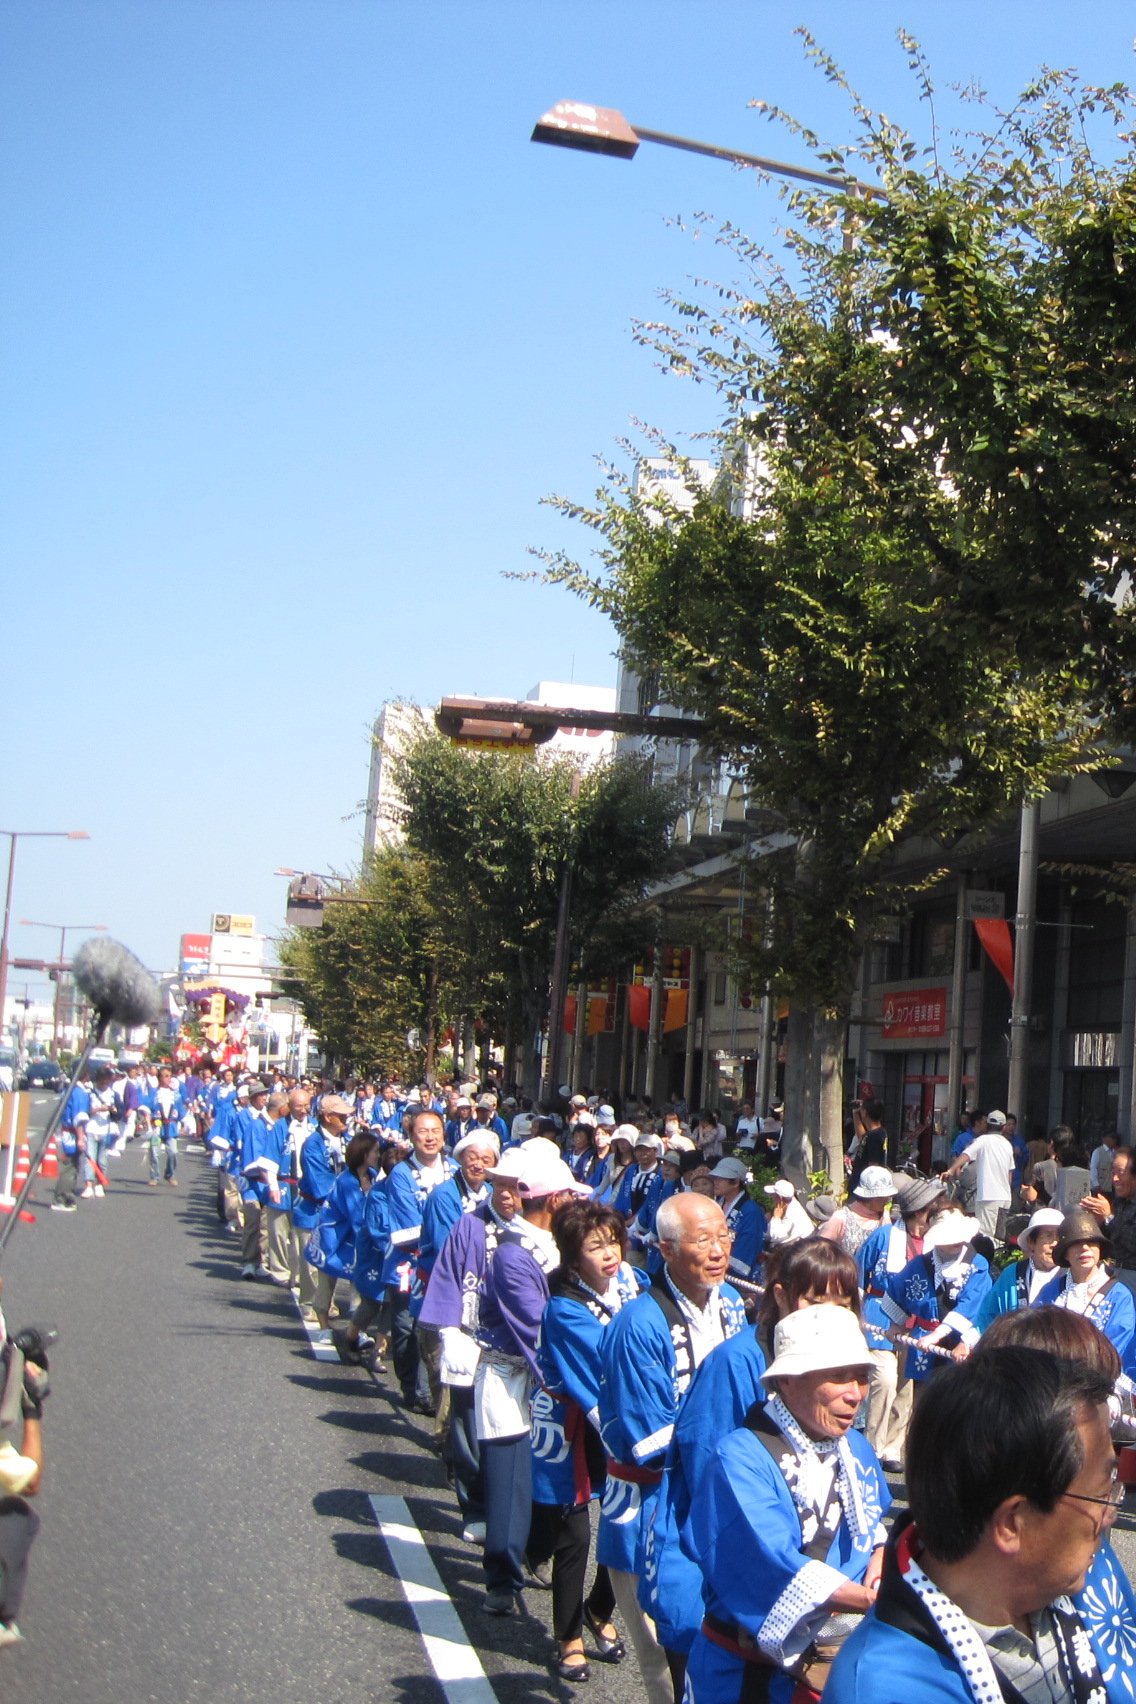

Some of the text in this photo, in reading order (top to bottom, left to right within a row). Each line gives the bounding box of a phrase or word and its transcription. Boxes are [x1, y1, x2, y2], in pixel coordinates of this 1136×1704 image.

[895, 1003, 941, 1023] カワイ音楽教室
